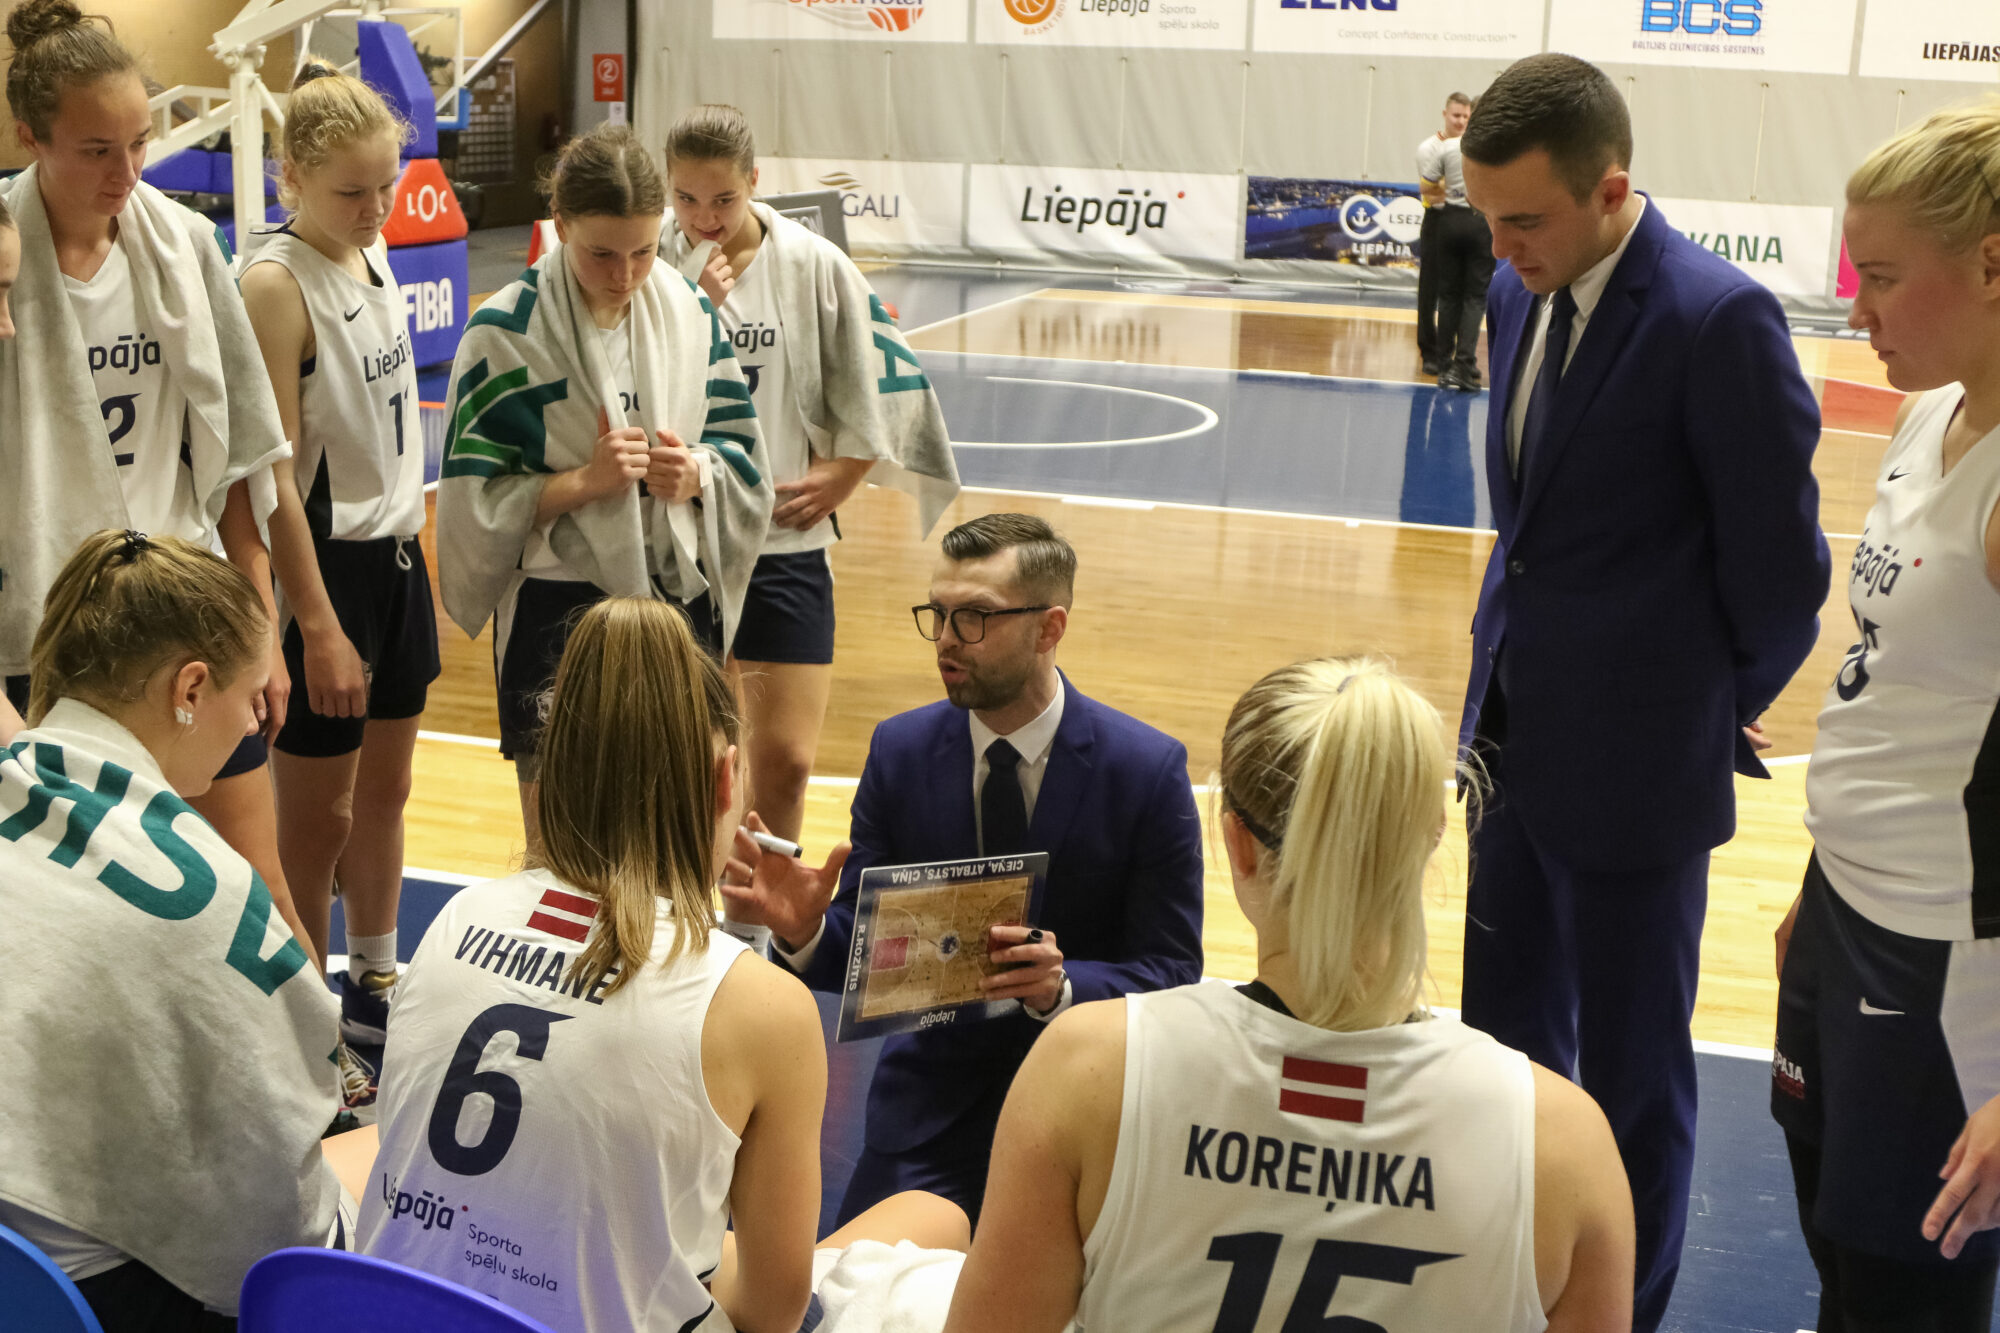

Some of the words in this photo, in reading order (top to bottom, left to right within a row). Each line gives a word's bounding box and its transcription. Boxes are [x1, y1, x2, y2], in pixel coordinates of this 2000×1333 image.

[1159, 4, 1197, 15] Sporta
[1191, 20, 1220, 30] skola
[1640, 0, 1763, 36] BCS
[1923, 41, 2000, 63] LIEPĀJAS
[603, 61, 613, 78] 2
[406, 184, 448, 222] LOC
[841, 193, 899, 221] GAĻI
[1021, 185, 1167, 235] Liepāja
[1389, 213, 1421, 225] LSEZ
[1351, 240, 1411, 257] LIEPĀJA
[400, 277, 454, 333] FIBA
[88, 332, 161, 378] pāja
[924, 864, 985, 880] ATBALSTS,
[455, 925, 621, 1005] VIHMANE
[920, 1010, 956, 1028] Liepāja
[428, 1003, 577, 1177] 6
[1184, 1124, 1435, 1213] KOREŅIKA
[468, 1223, 522, 1257] Sporta
[465, 1249, 506, 1275] spēļu
[511, 1266, 558, 1292] skola
